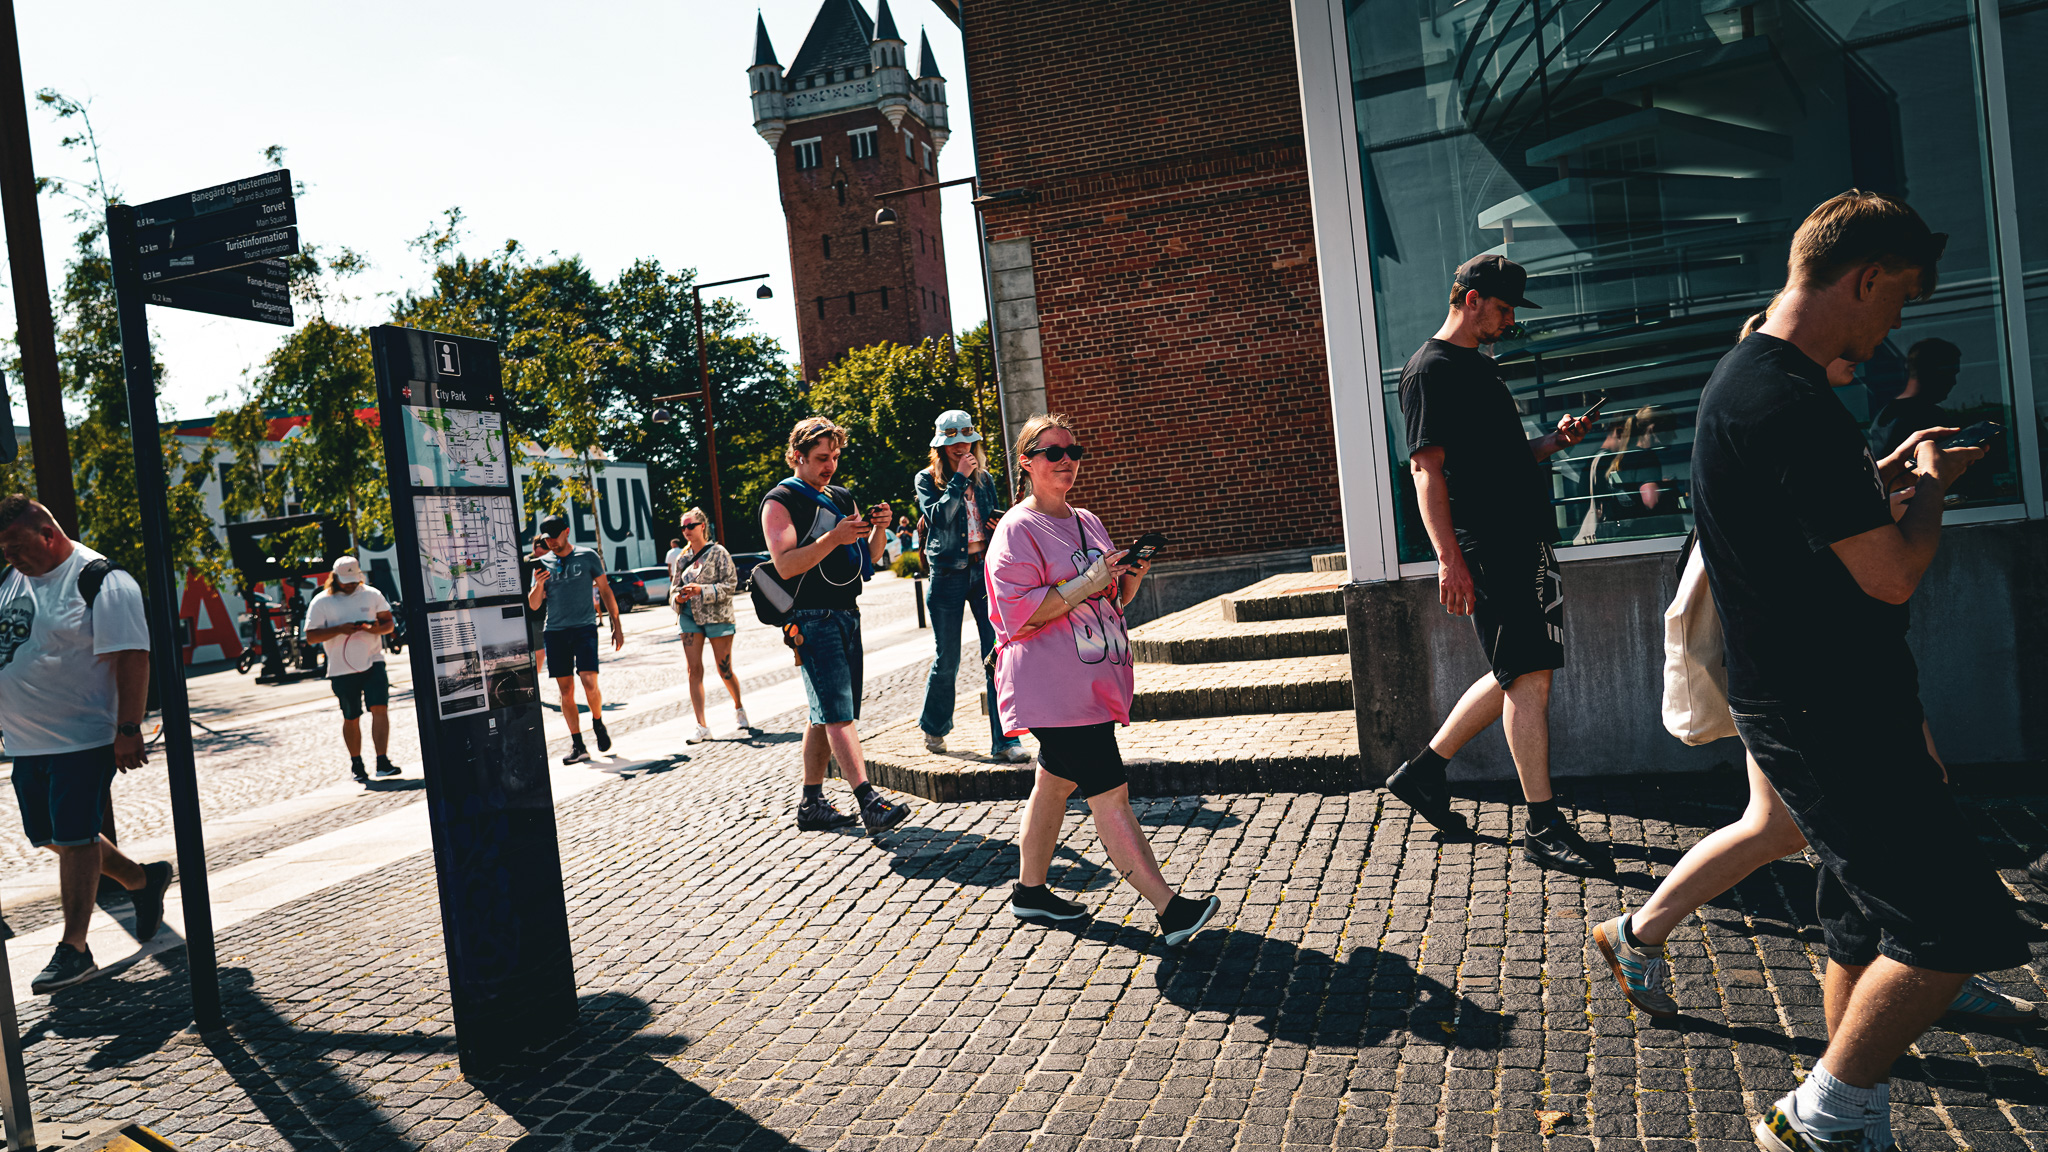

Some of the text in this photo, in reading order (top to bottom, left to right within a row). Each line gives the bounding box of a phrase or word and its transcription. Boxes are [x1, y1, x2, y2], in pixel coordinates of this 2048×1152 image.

[191, 172, 281, 203] Banegård og busterminal
[255, 191, 264, 199] Bus
[264, 186, 283, 197] Station
[261, 200, 286, 214] Torvet
[146, 217, 155, 225] km
[256, 214, 287, 227] Main Square
[149, 243, 159, 251] km
[225, 230, 289, 251] Turistinformation
[243, 244, 290, 259] Tourist Information
[152, 270, 162, 279] km
[162, 294, 173, 303] km
[251, 299, 291, 314] Landgangen
[434, 389, 467, 402] City Park
